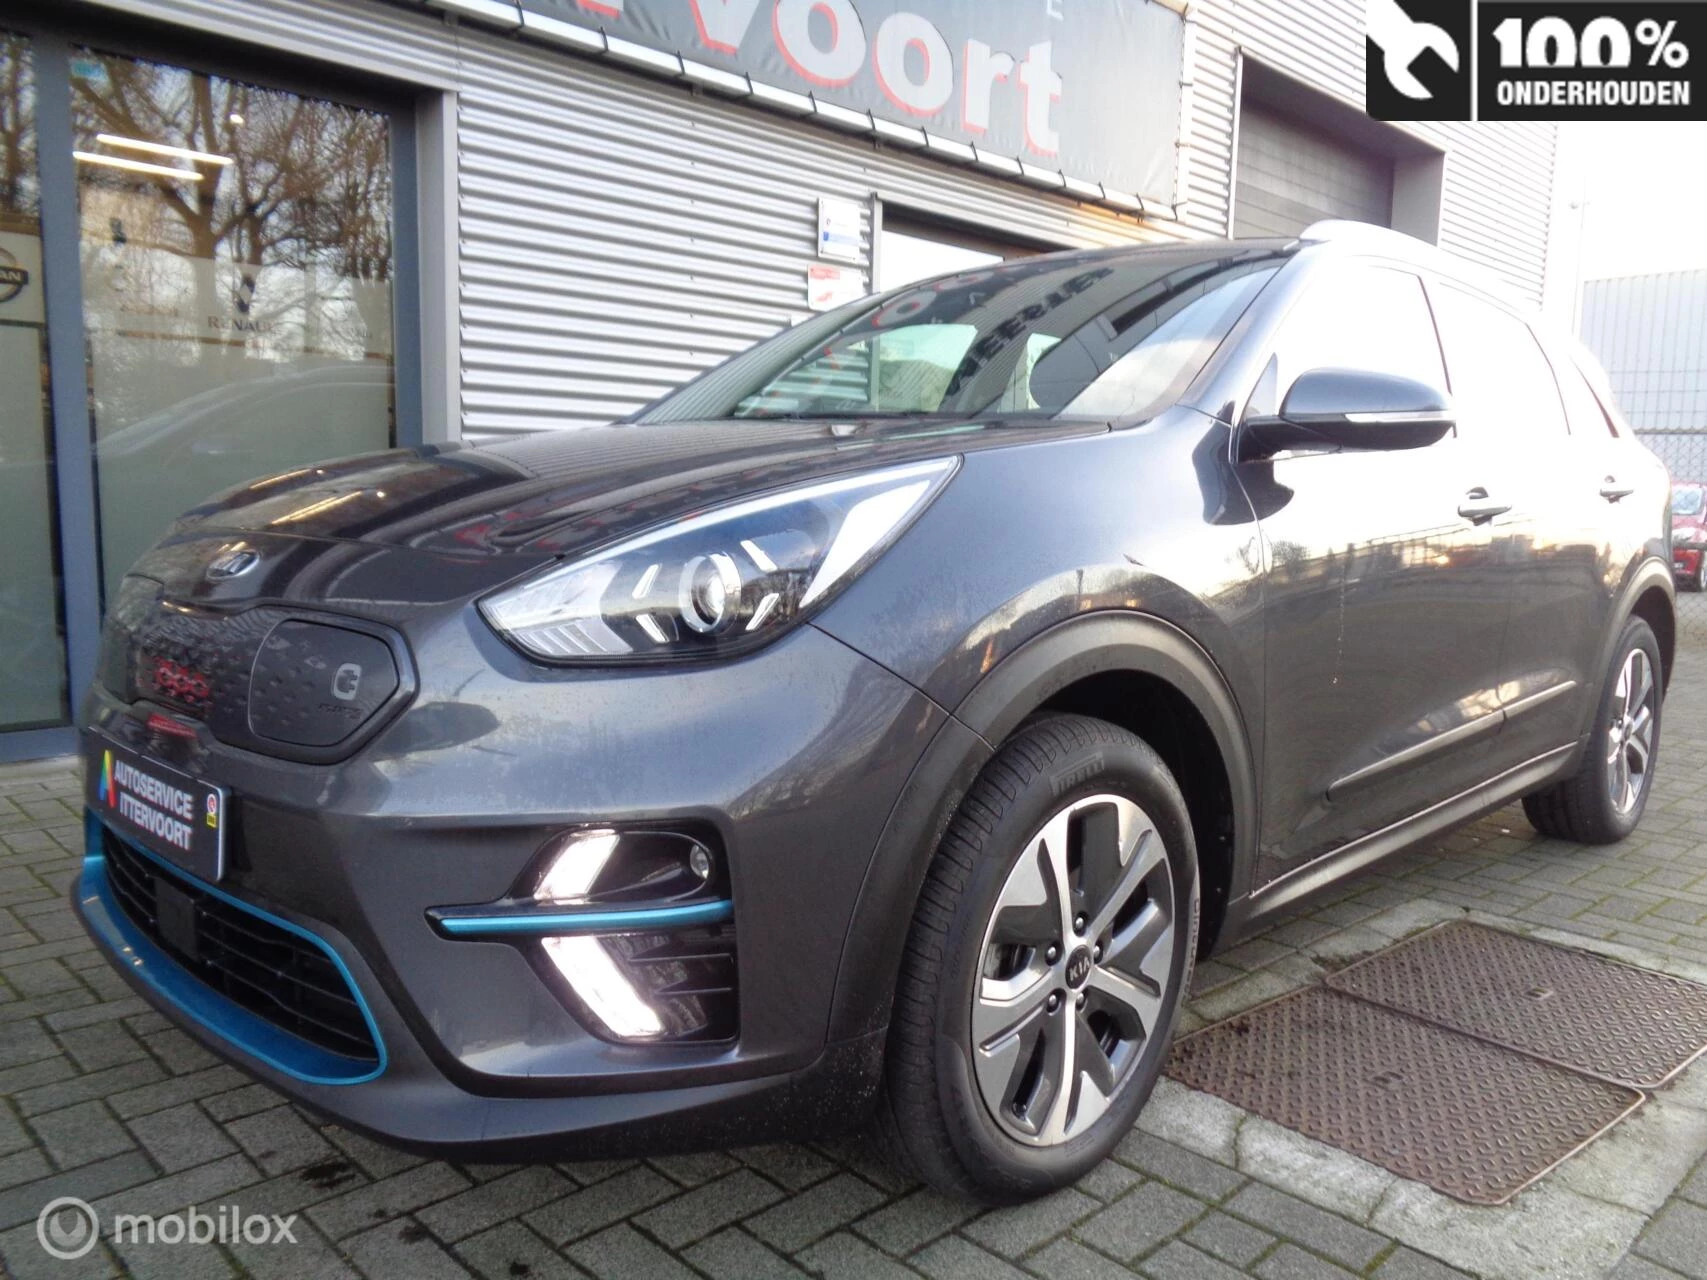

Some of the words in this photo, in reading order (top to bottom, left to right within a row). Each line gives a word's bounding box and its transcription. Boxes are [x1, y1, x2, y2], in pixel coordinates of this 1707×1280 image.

[114, 759, 193, 820] AUTOSERVICE
[119, 791, 192, 851] ITTERVOORT
[1069, 956, 1090, 982] KIA
